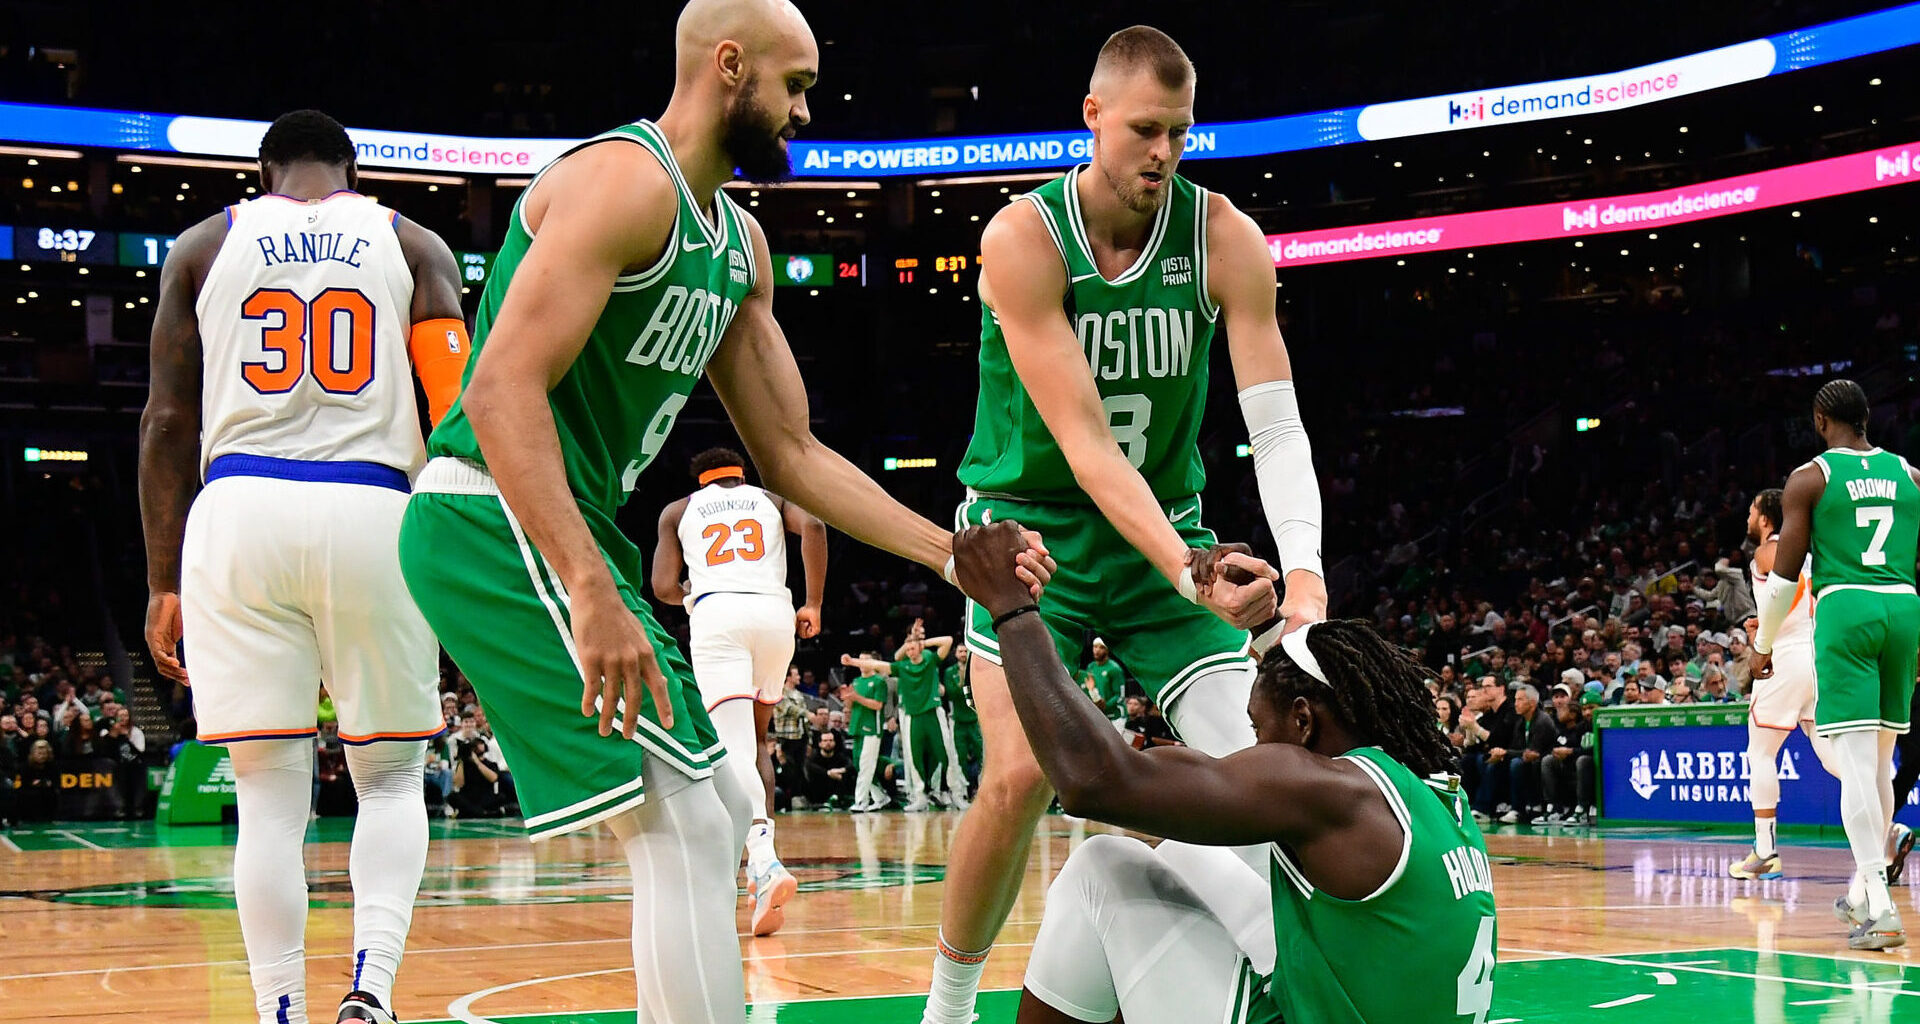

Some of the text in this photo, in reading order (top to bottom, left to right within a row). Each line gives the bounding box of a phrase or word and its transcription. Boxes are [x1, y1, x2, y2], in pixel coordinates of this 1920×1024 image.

[1491, 73, 1679, 116] demandscience
[356, 142, 530, 166] mandscience
[803, 146, 959, 169] AI-POWERED
[963, 140, 1063, 164] DEMAND
[1600, 186, 1757, 225] demandscience
[37, 227, 96, 251] 8:37
[144, 238, 176, 265] 1
[256, 232, 370, 268] RANDLE
[1284, 228, 1441, 260] demandscience
[465, 265, 485, 281] 80
[839, 262, 858, 278] 24
[1160, 256, 1191, 274] VISTA
[1162, 271, 1192, 286] PRINT
[241, 287, 376, 395] 30
[625, 285, 738, 379] BOSTO
[1074, 307, 1194, 380] OSTON
[622, 392, 688, 492] 9
[1845, 478, 1897, 501] BROWN
[697, 499, 758, 518] ROBINSON
[702, 518, 766, 567] 23
[1855, 506, 1894, 566] 7
[61, 773, 113, 788] DEN
[1671, 784, 1780, 802] INSURAN
[1441, 846, 1494, 900] HOLID
[1456, 915, 1496, 1024] 4
